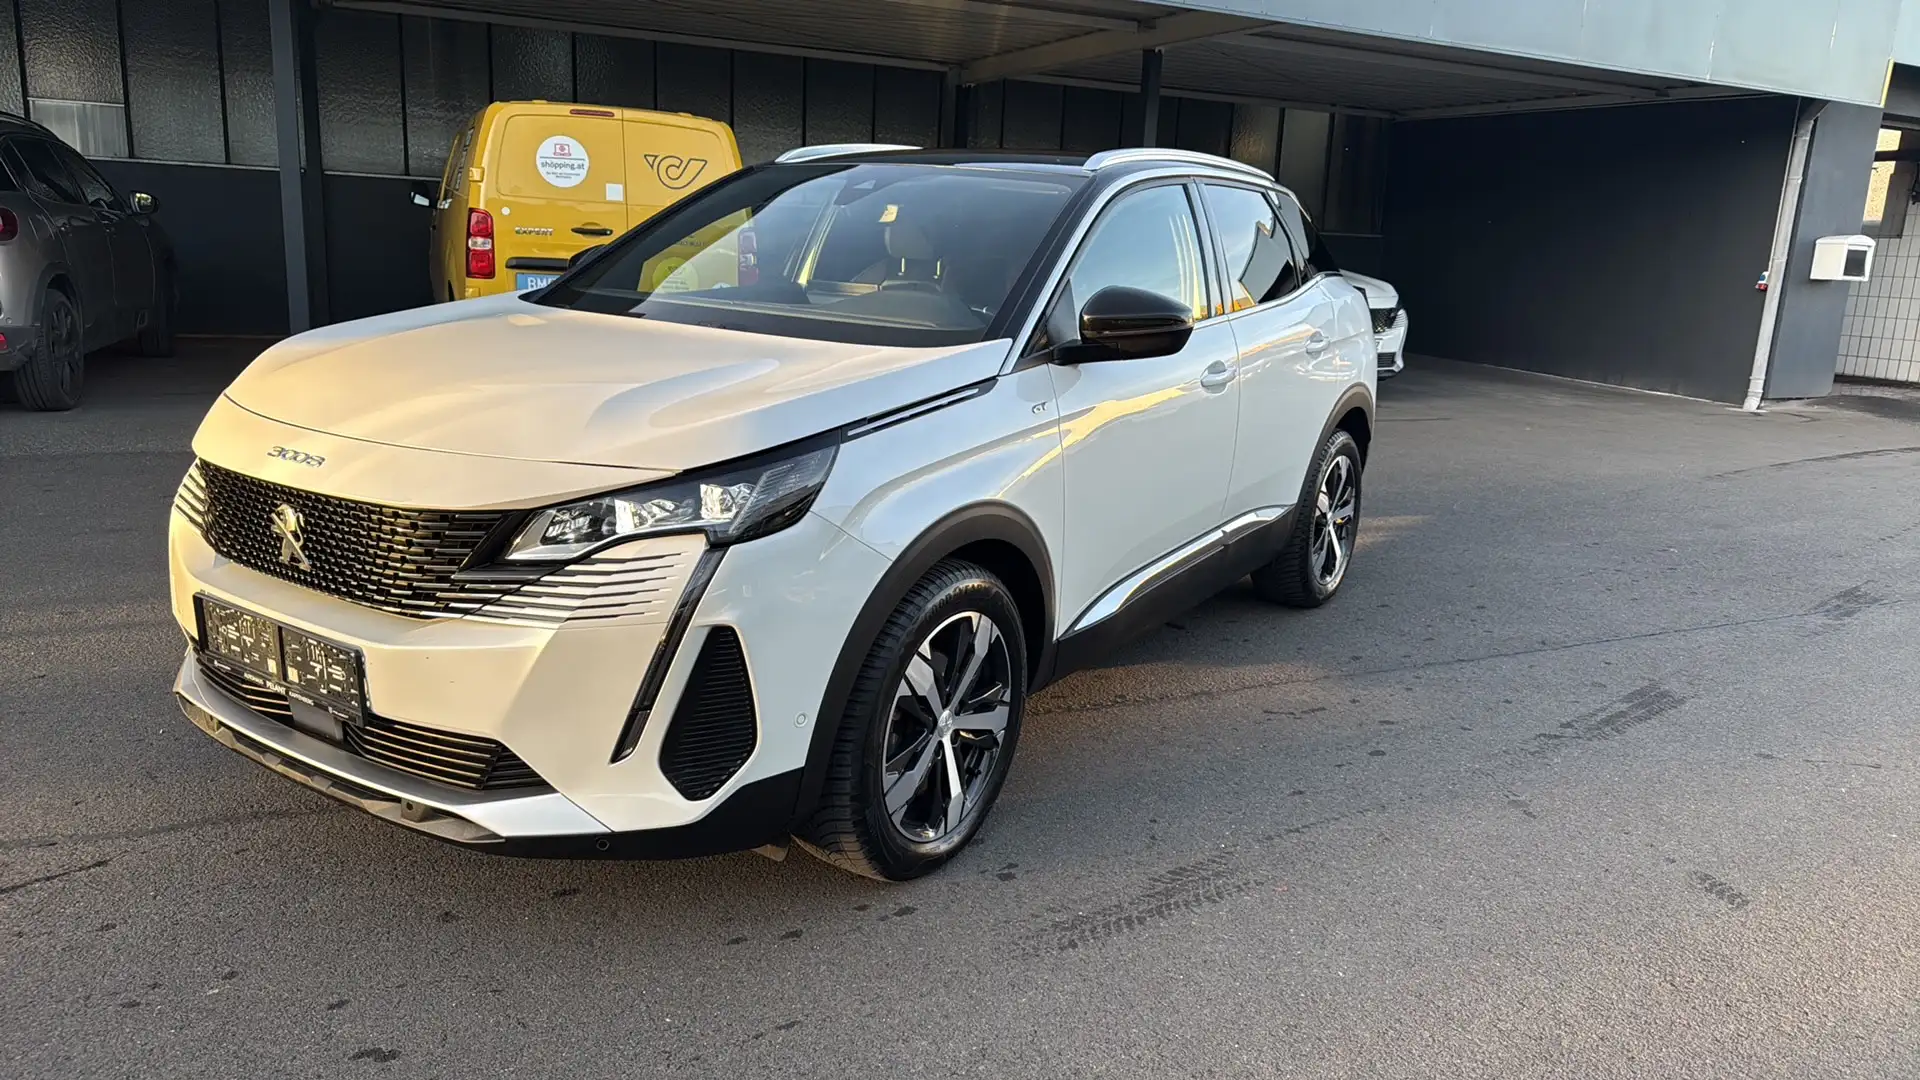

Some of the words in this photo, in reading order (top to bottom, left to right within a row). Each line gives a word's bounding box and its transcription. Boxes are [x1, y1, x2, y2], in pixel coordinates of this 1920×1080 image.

[514, 227, 554, 236] EXPERT
[1031, 401, 1048, 415] GT
[266, 445, 326, 468] 3008
